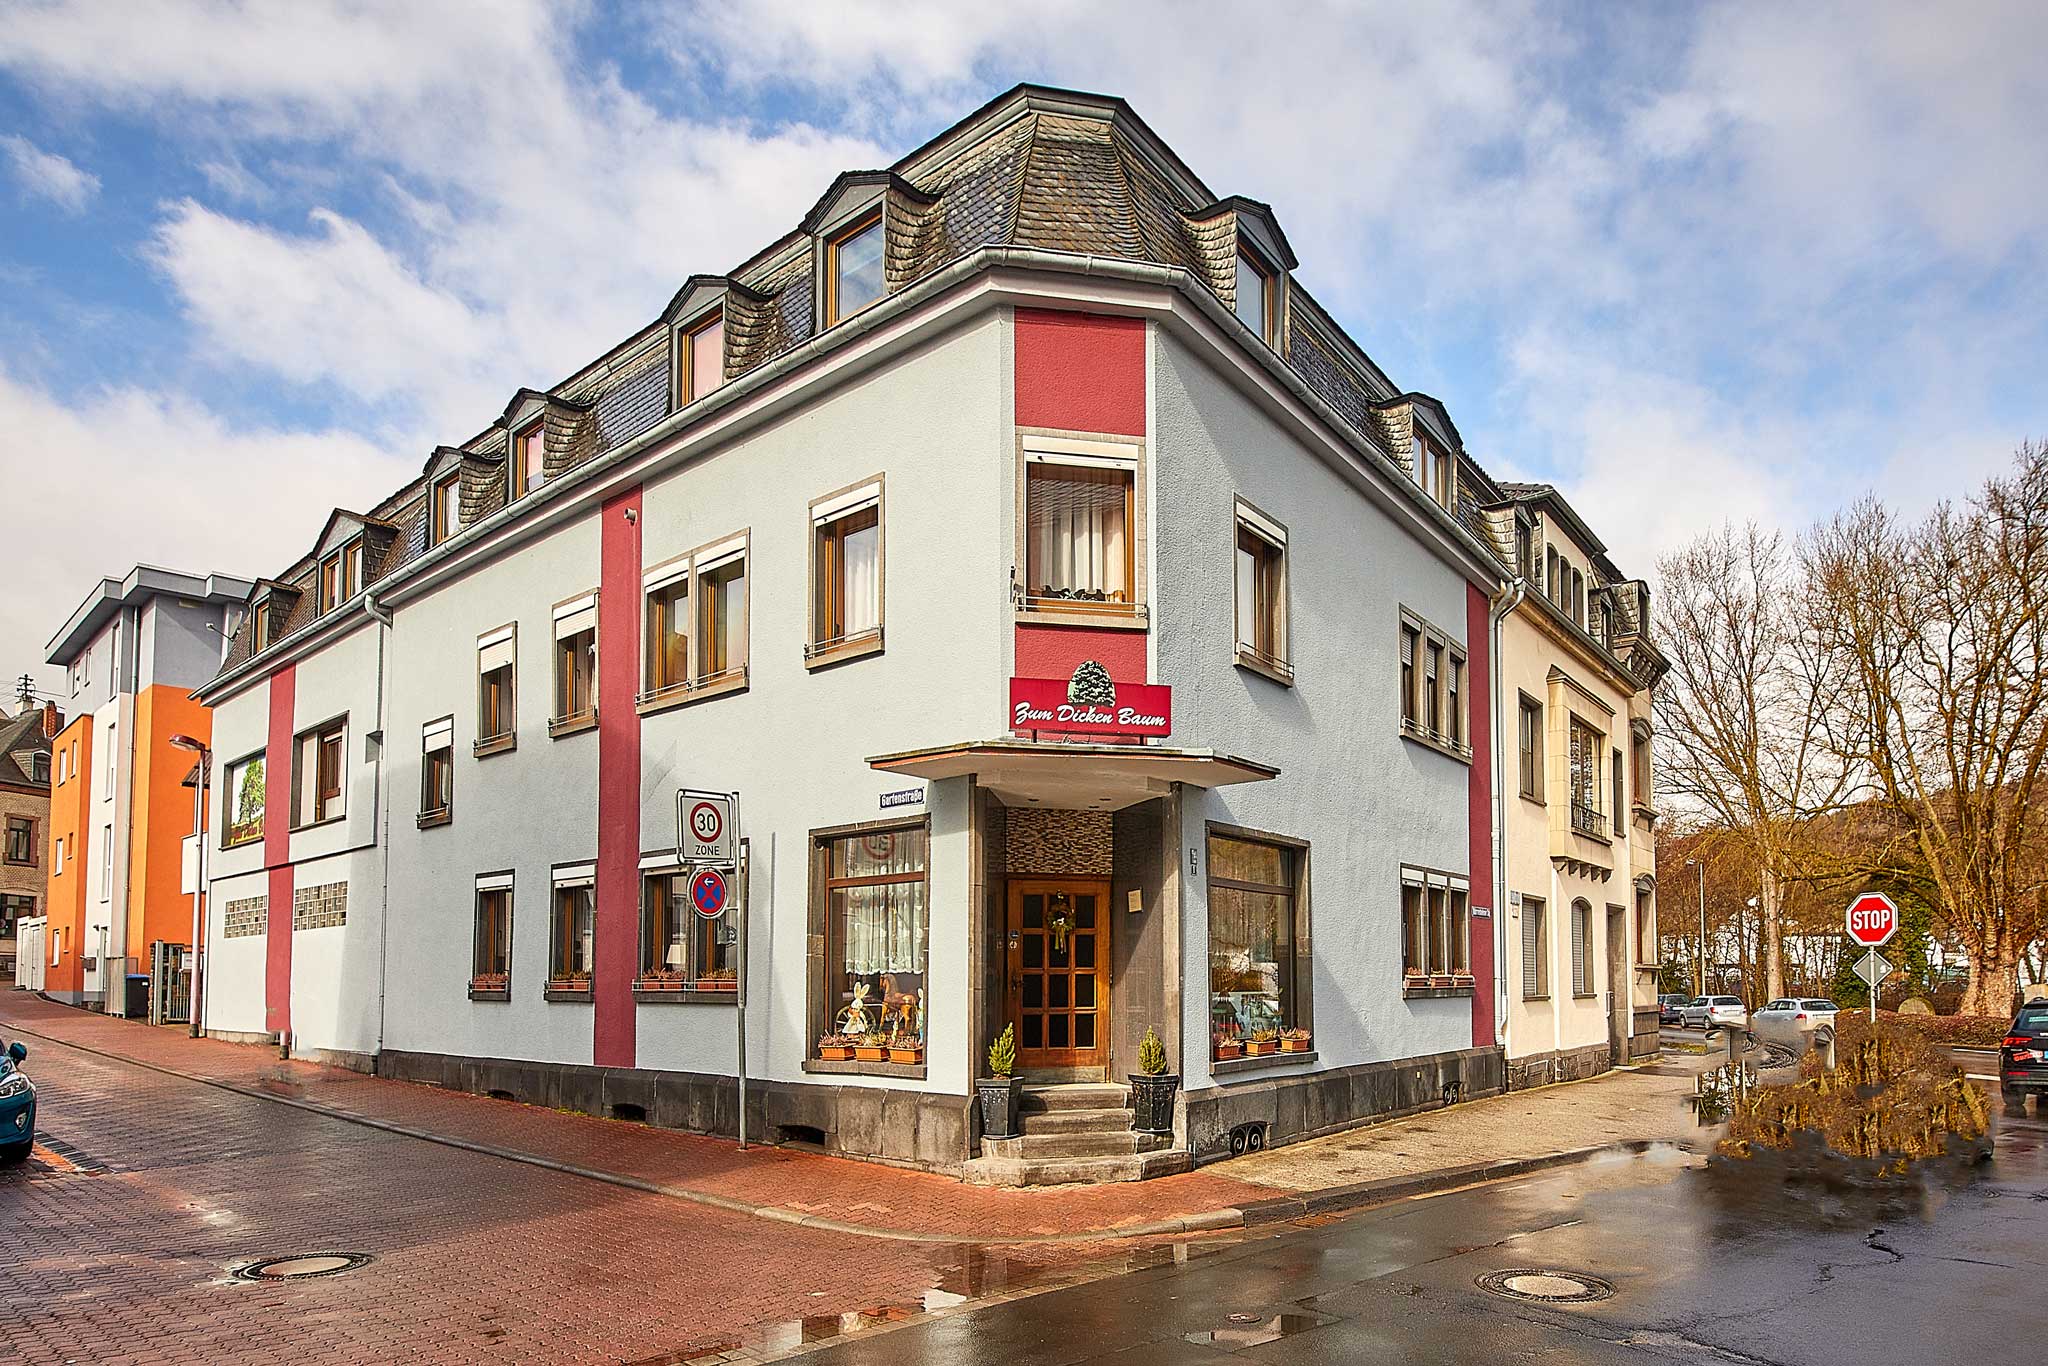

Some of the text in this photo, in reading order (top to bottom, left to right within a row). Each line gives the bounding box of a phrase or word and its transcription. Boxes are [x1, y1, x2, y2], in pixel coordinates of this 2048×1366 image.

[1014, 702, 1167, 727] Zum Dicken Baum
[881, 789, 923, 807] Gartenstraße
[696, 813, 716, 832] 30
[695, 845, 720, 856] ZONE
[1852, 909, 1891, 930] STOP
